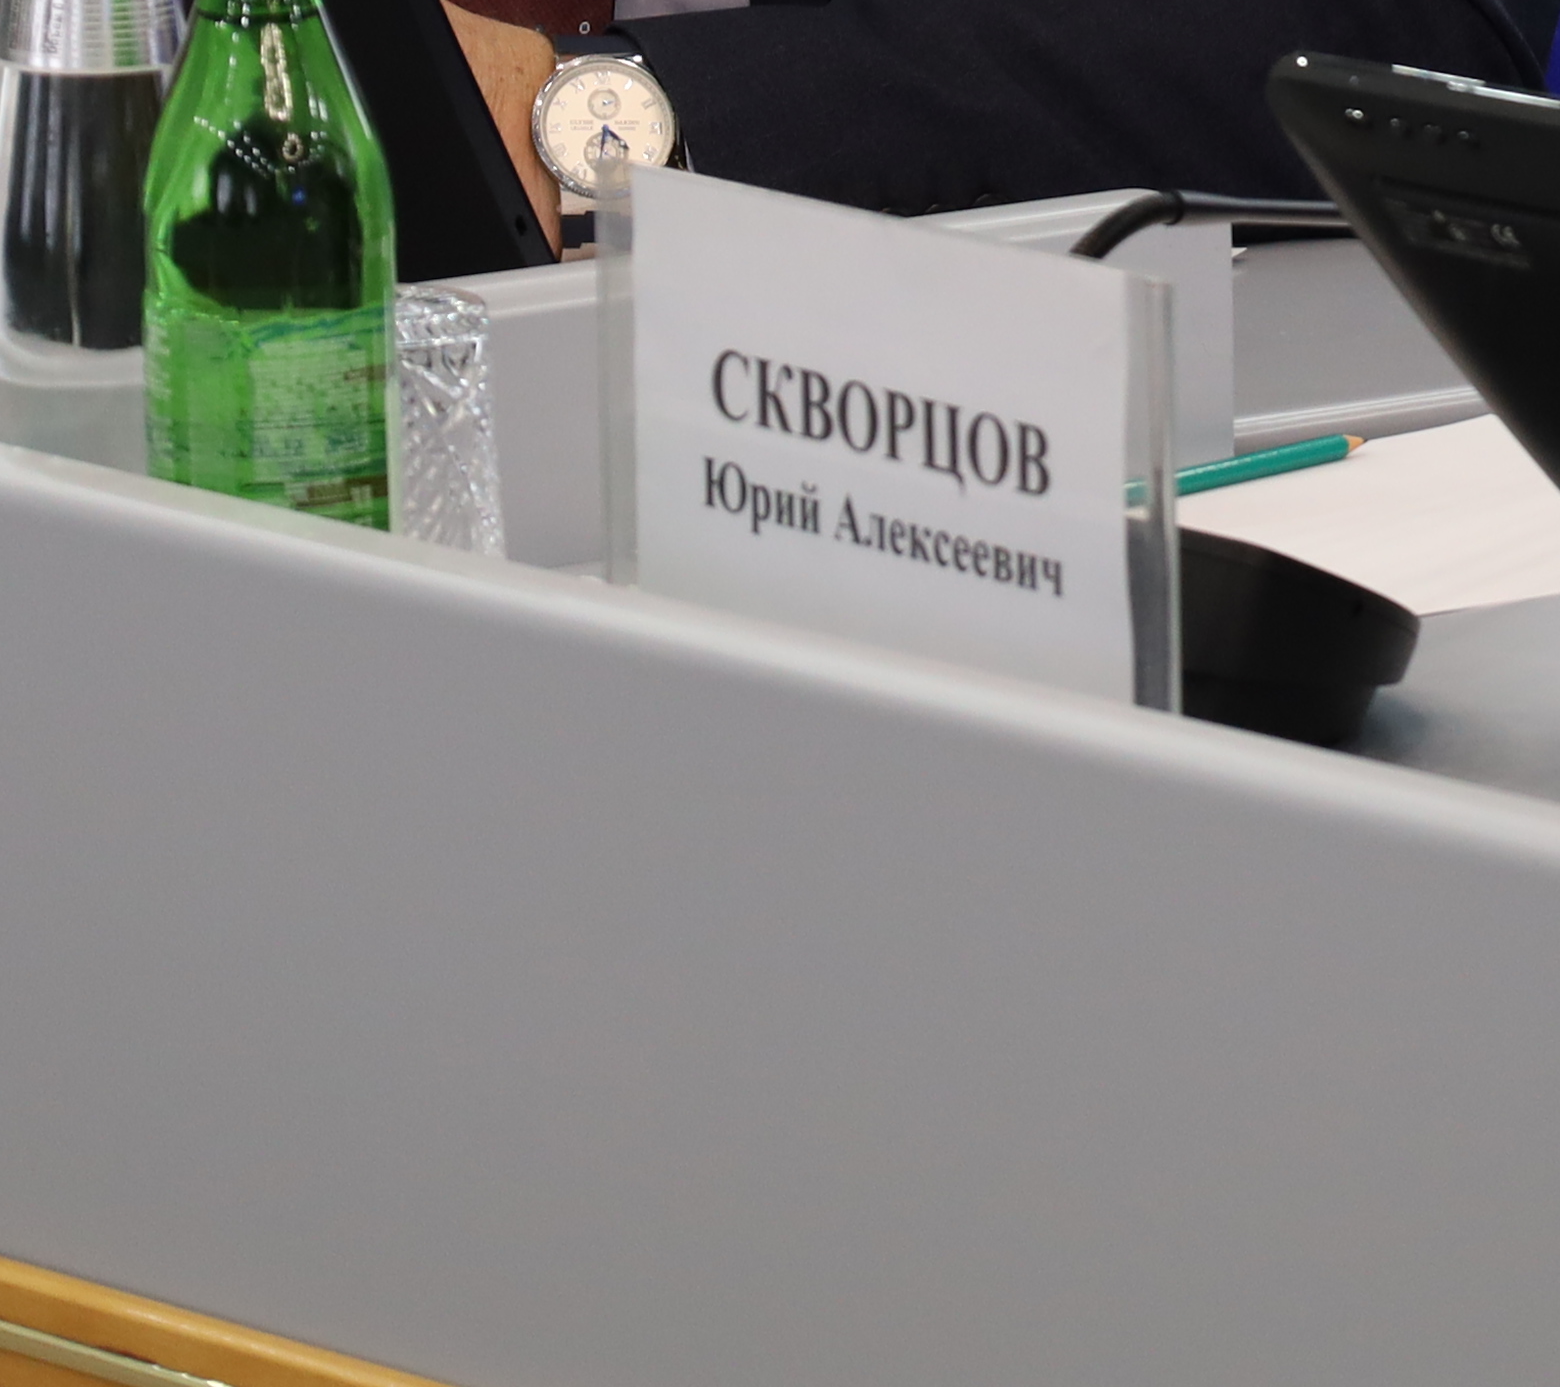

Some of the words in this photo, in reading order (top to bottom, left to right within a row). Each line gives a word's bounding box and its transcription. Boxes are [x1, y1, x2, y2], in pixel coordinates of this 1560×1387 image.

[711, 349, 1052, 498] СКВОРЦОВ
[703, 456, 822, 536] Юрий
[834, 495, 1065, 599] Алексеевич
